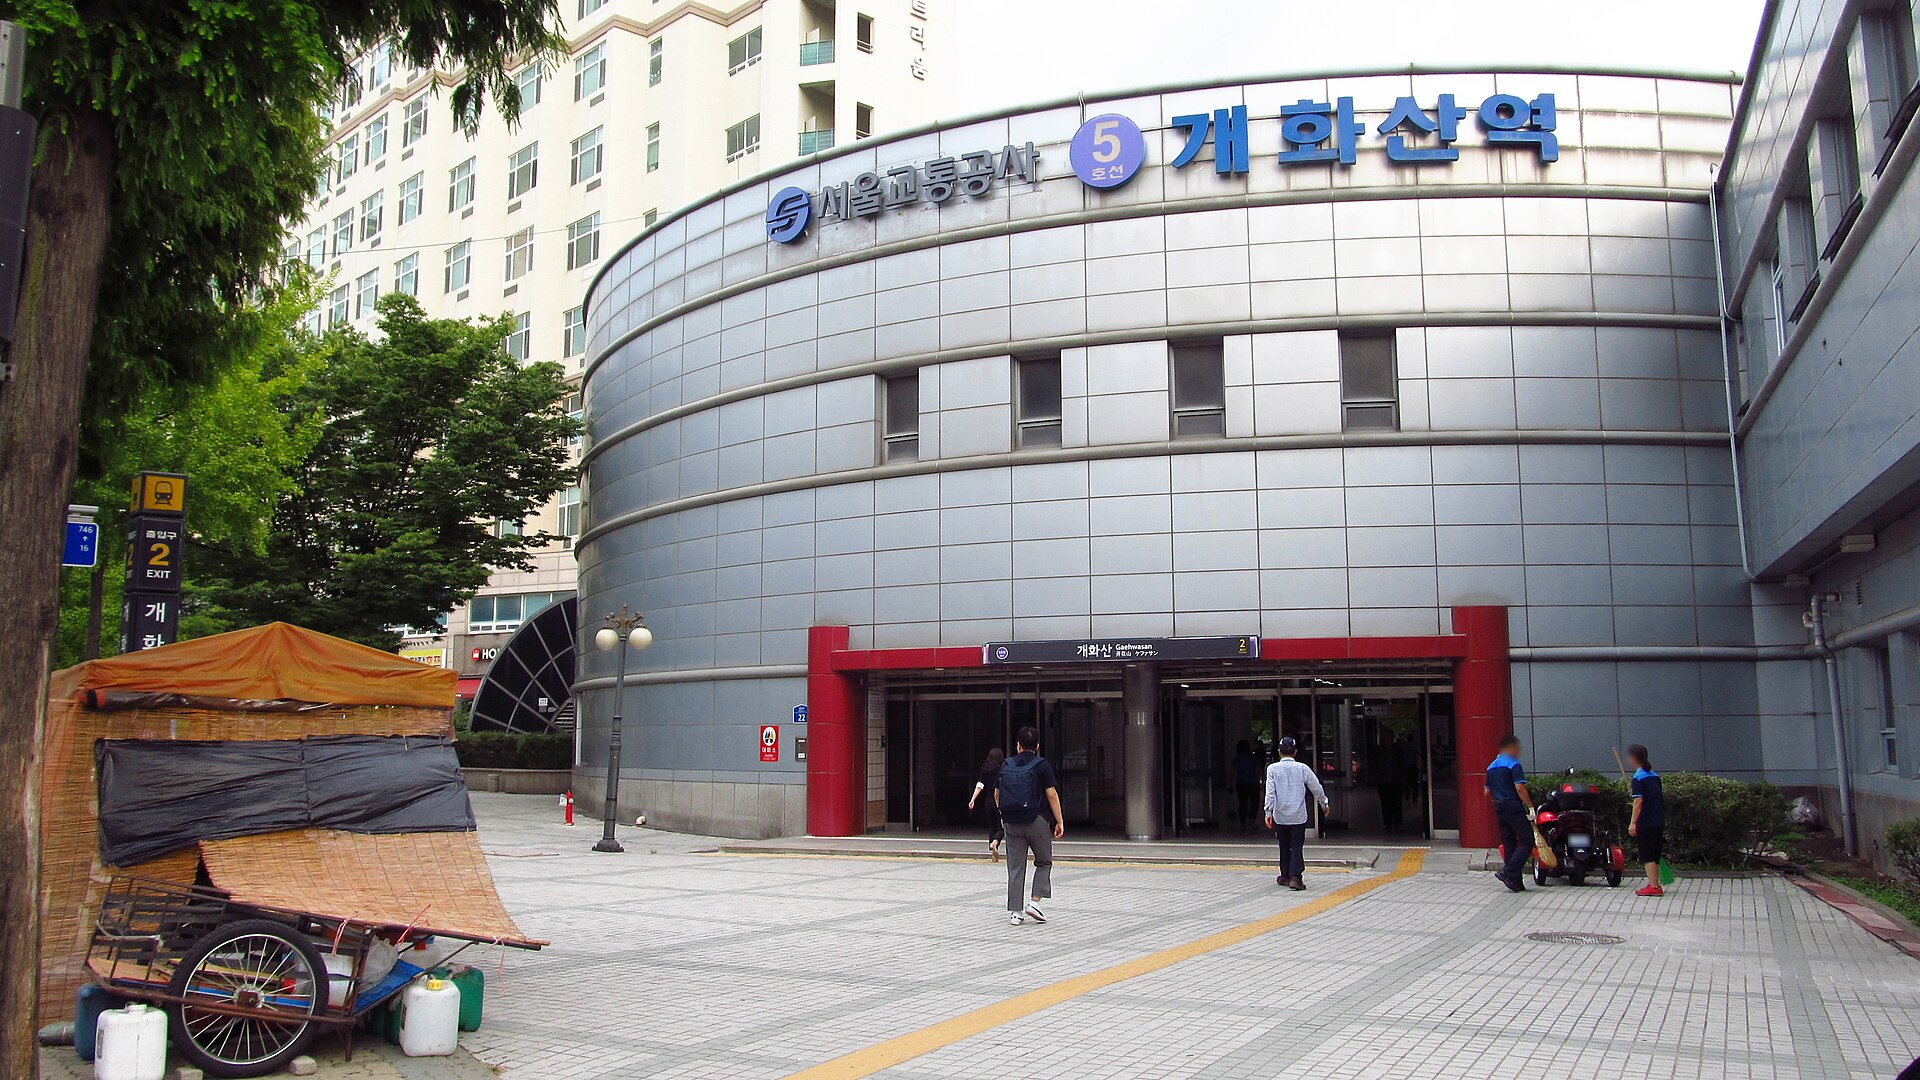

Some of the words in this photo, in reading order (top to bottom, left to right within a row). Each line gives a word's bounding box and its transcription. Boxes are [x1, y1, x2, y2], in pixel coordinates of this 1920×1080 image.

[1171, 93, 1559, 174] 개화산역
[1092, 120, 1121, 163] 5
[1090, 165, 1124, 180] 호선
[818, 141, 1040, 220] 서울교통공사
[78, 525, 93, 534] 746
[145, 530, 177, 540] 출입구
[80, 544, 89, 552] 16
[149, 543, 170, 566] 2
[146, 569, 171, 579] EXIT
[1115, 643, 1153, 651] Gaehwasan
[1239, 638, 1246, 648] 2
[482, 648, 500, 660] HO
[1076, 643, 1113, 658] 개화산
[798, 714, 806, 722] 22
